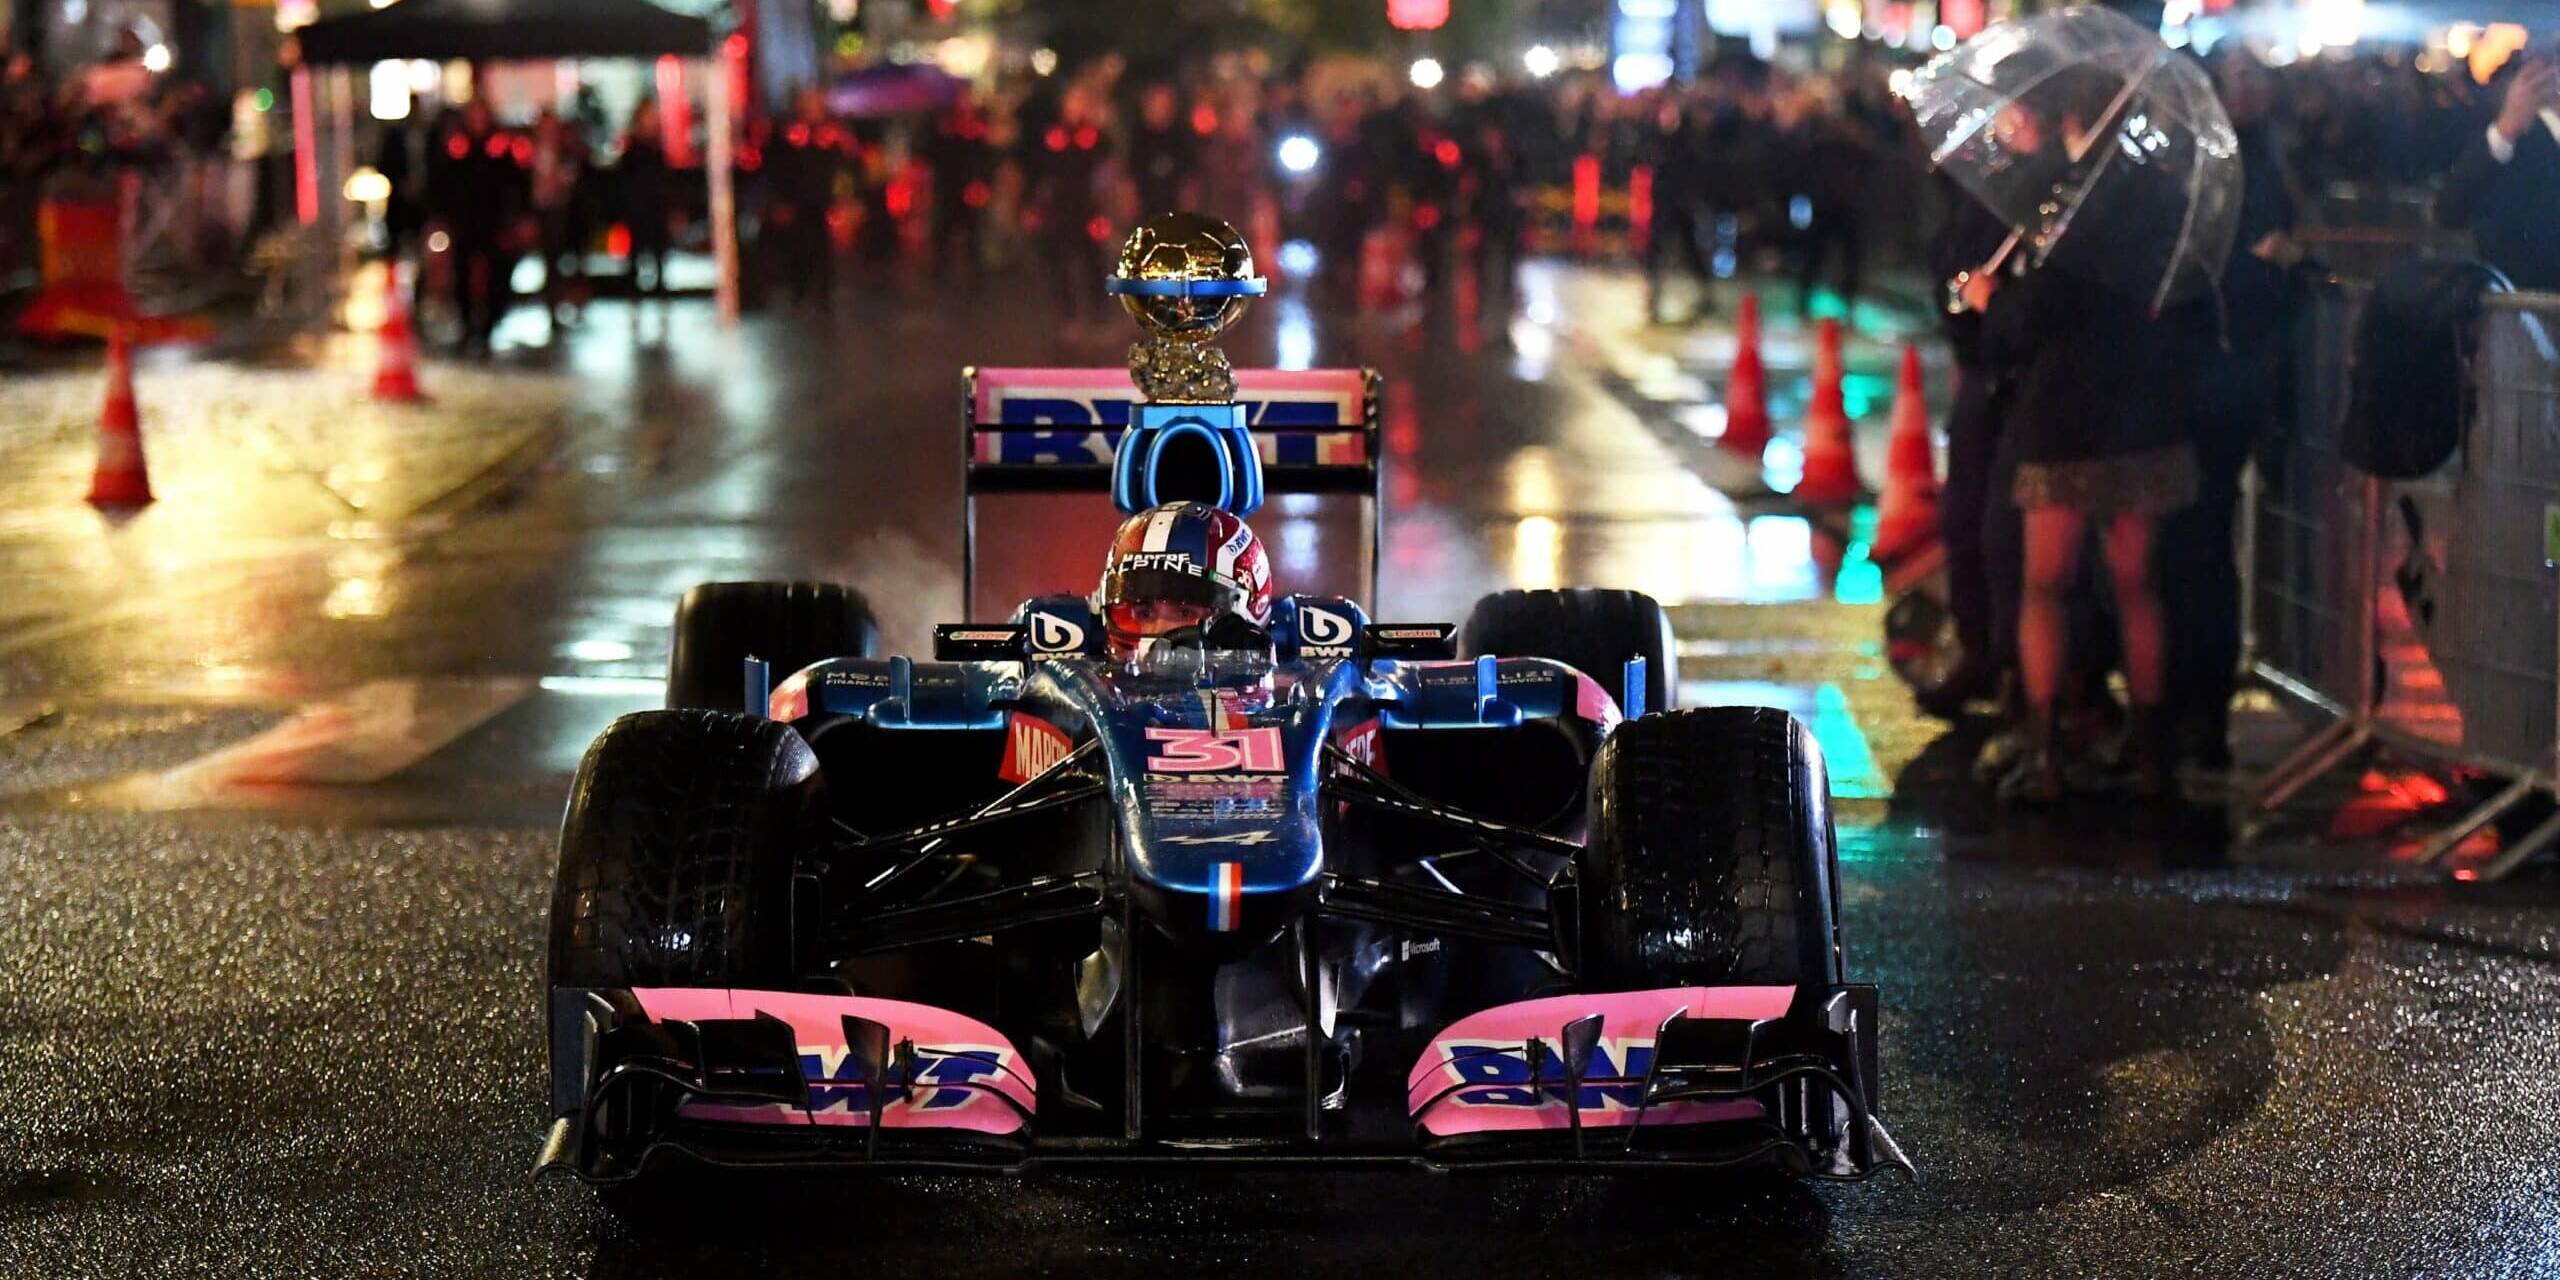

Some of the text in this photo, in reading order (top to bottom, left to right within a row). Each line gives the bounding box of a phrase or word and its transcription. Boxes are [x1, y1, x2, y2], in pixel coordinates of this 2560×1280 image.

[1001, 398, 1339, 465] BT
[1108, 559, 1203, 578] ALPINE
[1300, 647, 1353, 658] BWT
[1144, 727, 1285, 771] 31
[788, 1050, 1005, 1112] WT
[1450, 1045, 1656, 1107] BW
